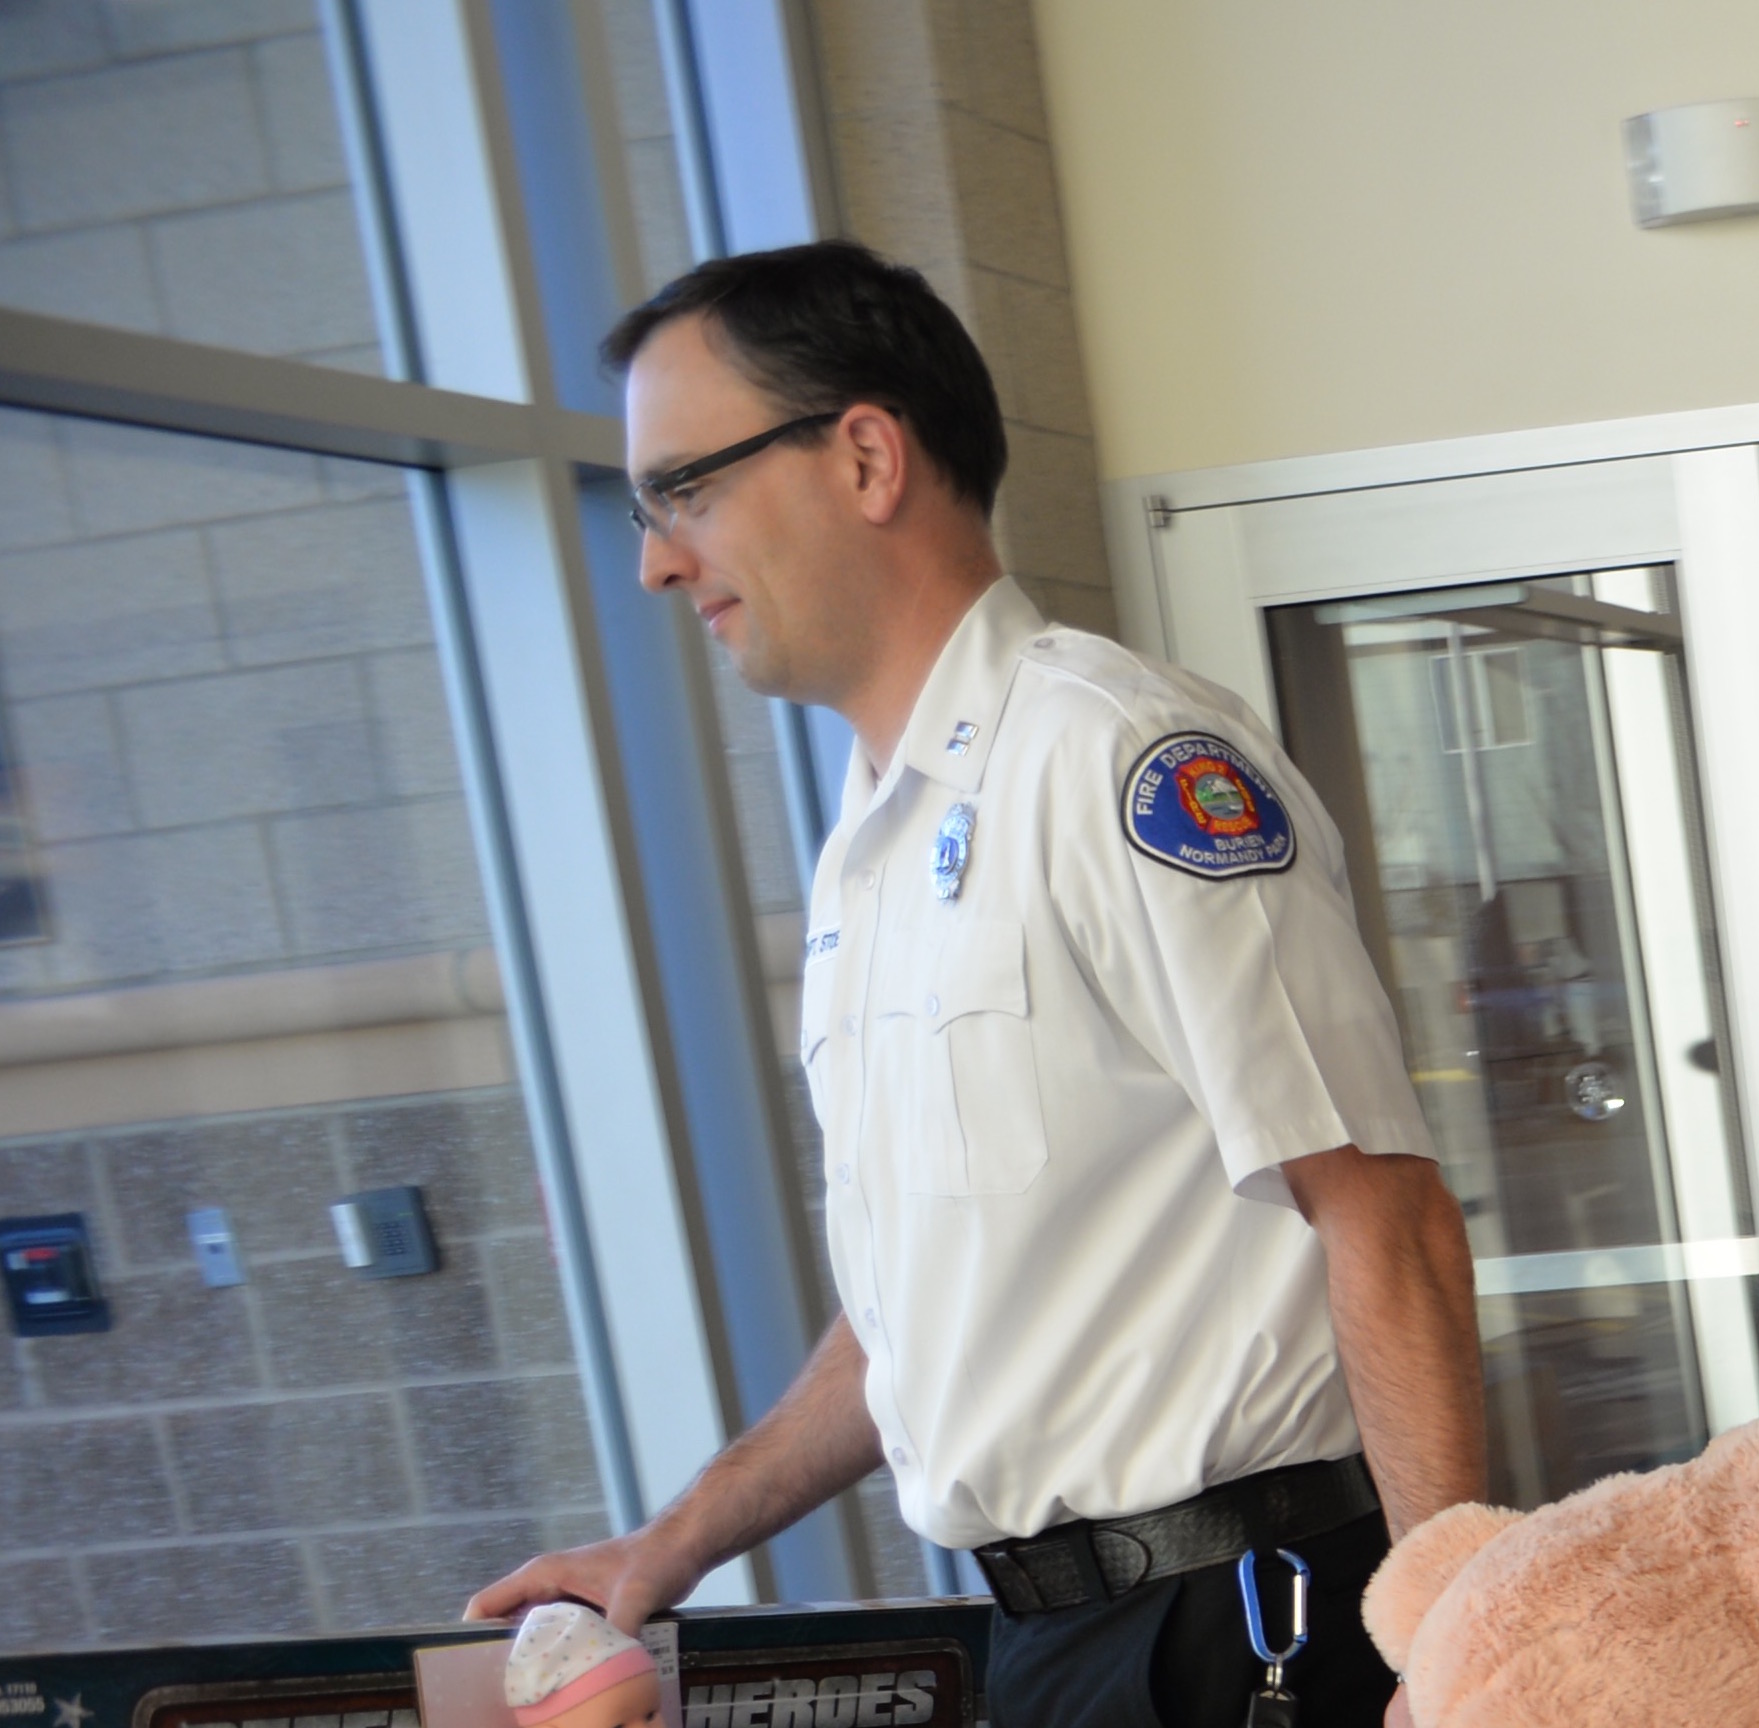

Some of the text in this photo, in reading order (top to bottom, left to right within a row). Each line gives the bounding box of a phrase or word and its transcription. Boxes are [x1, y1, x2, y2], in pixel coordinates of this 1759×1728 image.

[1135, 769, 1164, 816] FIRE
[1159, 740, 1274, 801] DEPARTMENT
[1213, 833, 1266, 852] BURIEN
[1178, 843, 1267, 865] NORMANDY
